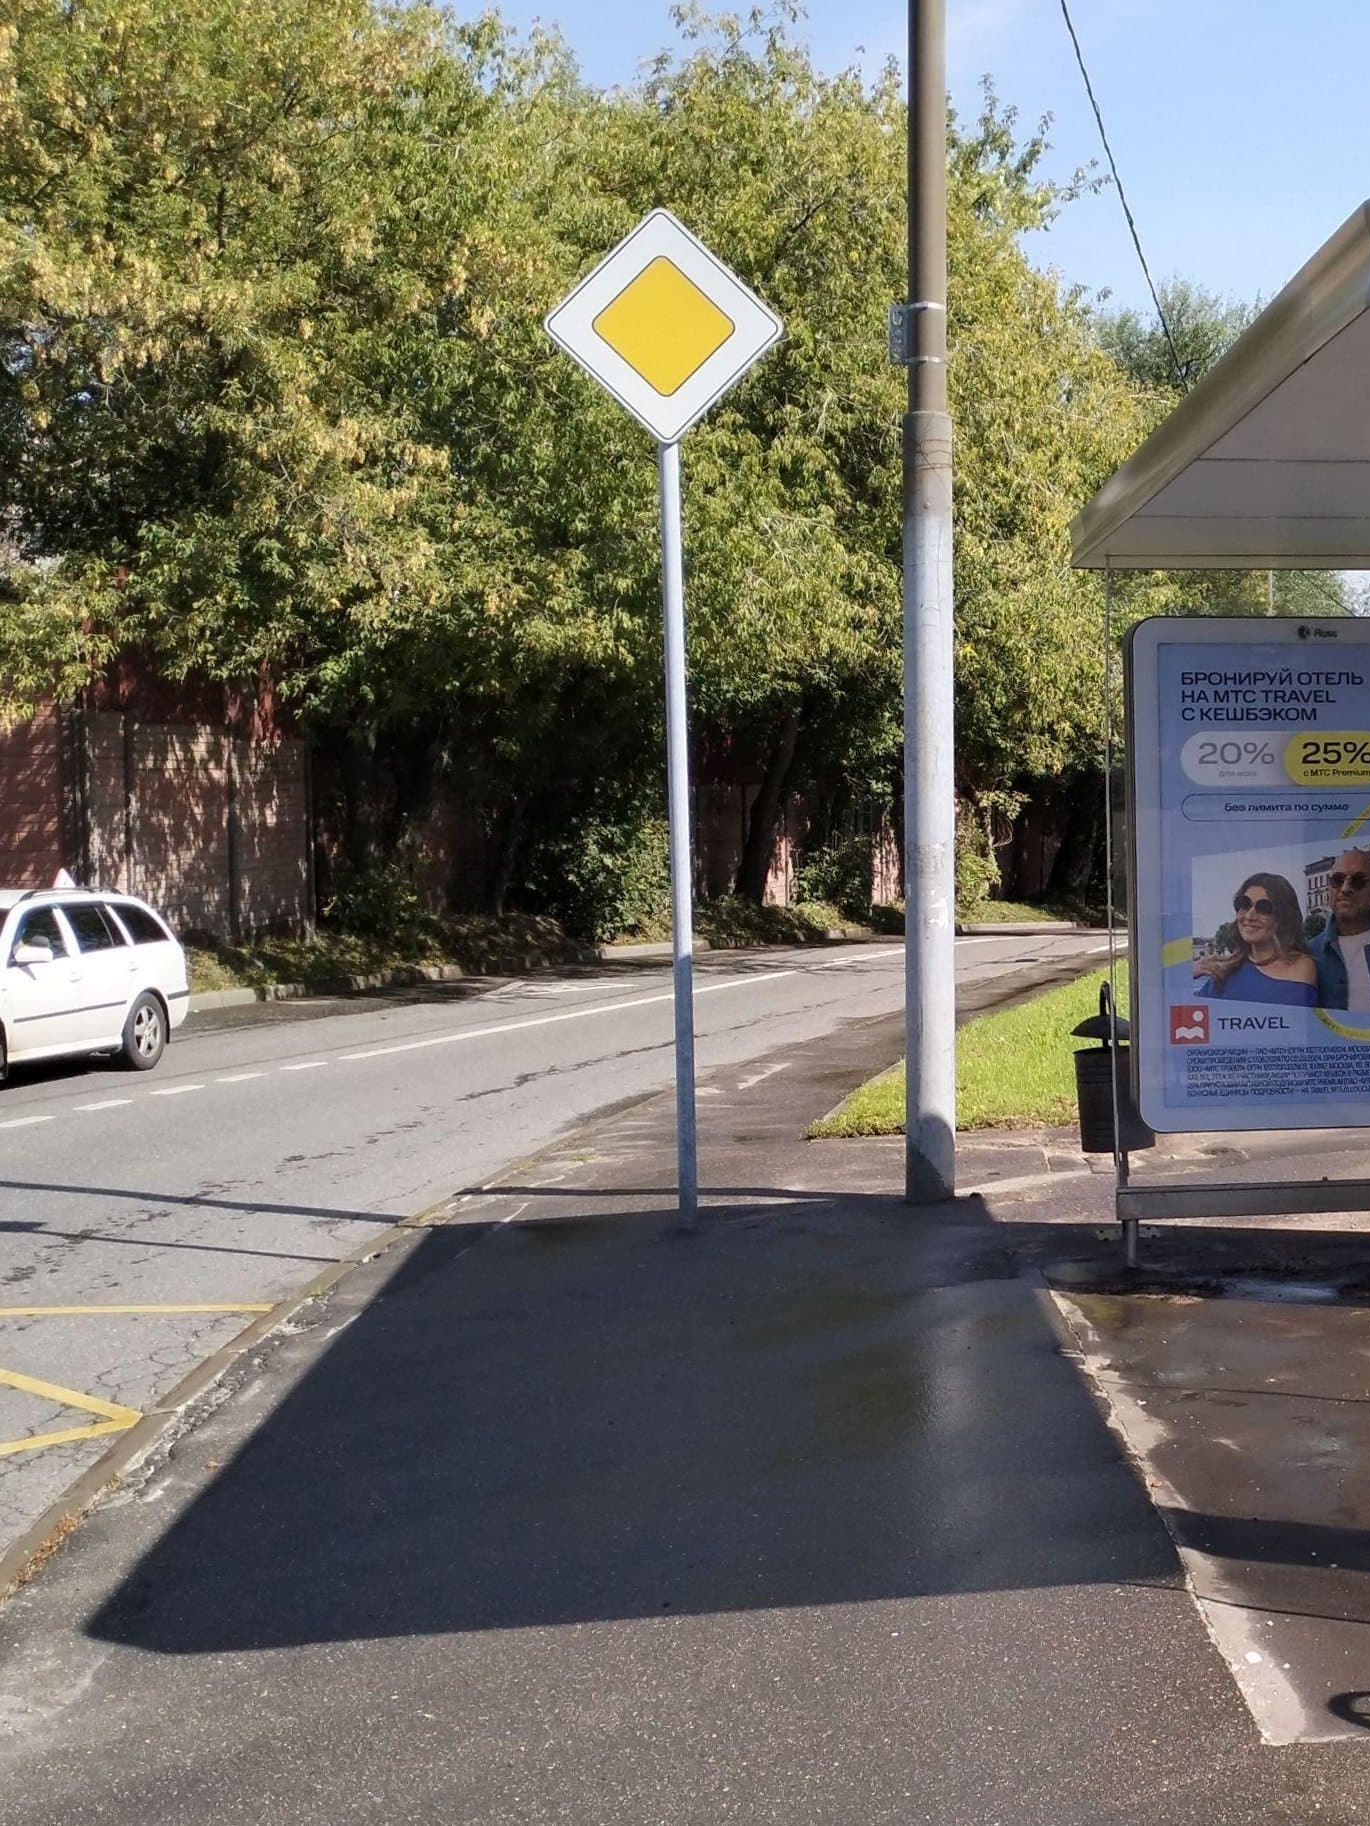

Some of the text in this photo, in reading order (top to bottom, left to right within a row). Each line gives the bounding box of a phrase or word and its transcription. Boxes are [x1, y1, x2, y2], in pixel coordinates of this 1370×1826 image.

[1181, 669, 1363, 686] БРОНИРУЙ ОТЕЛЬ
[1181, 689, 1336, 704] НА МТС TRAVEL
[1181, 707, 1317, 722] С КЕШБЭКОМ
[1198, 741, 1275, 765] 20%
[1332, 768, 1370, 777] Premium
[1224, 802, 1246, 812] без
[1248, 803, 1292, 812] лимита
[1294, 803, 1308, 813] по
[1310, 803, 1350, 815] сумме
[1217, 1016, 1290, 1030] TRAVEL
